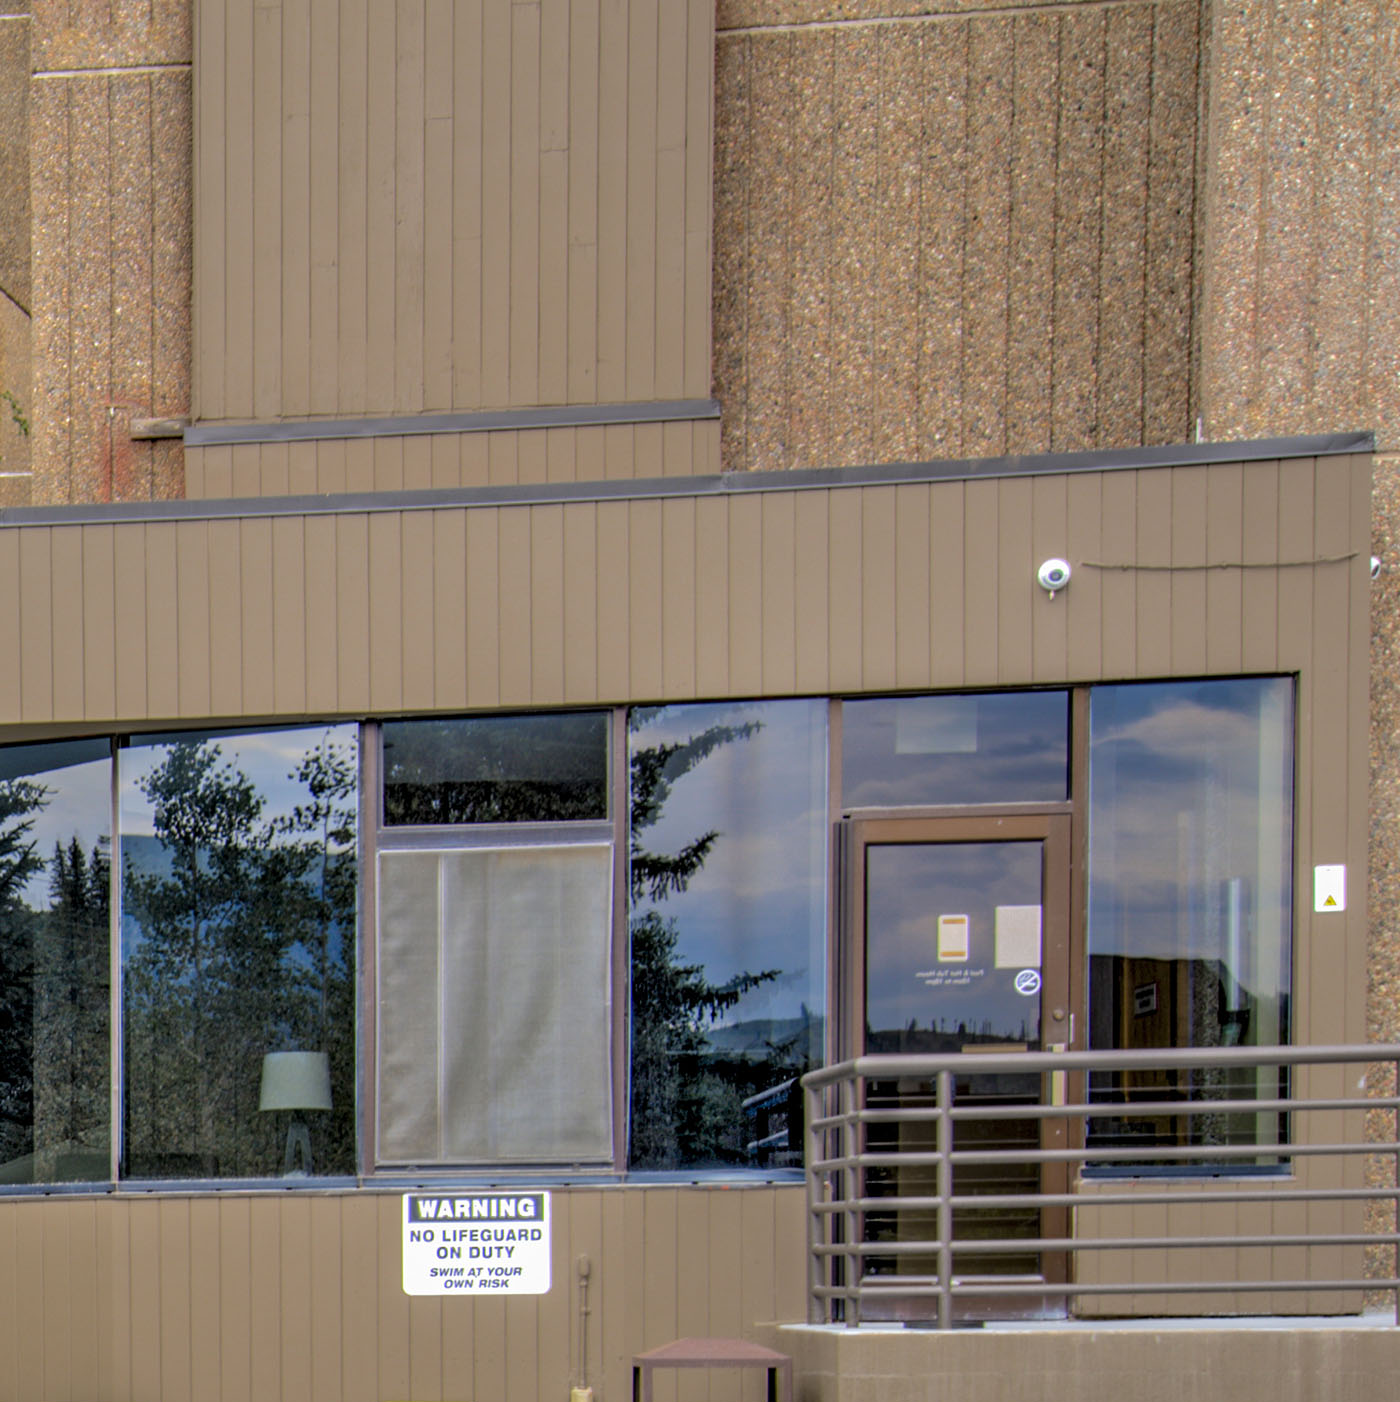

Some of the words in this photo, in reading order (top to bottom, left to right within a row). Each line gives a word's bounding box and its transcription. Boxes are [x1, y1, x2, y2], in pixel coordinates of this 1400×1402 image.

[417, 1198, 536, 1219] WARNING
[410, 1230, 435, 1242] NO
[442, 1229, 542, 1242] LIFEGUARD
[437, 1246, 461, 1259] ON
[469, 1246, 515, 1259] DUTY
[430, 1267, 464, 1277] SWIM
[468, 1267, 483, 1277] AT
[488, 1267, 523, 1276] YOUR
[444, 1279, 474, 1289] OWN
[479, 1279, 510, 1288] RISK
